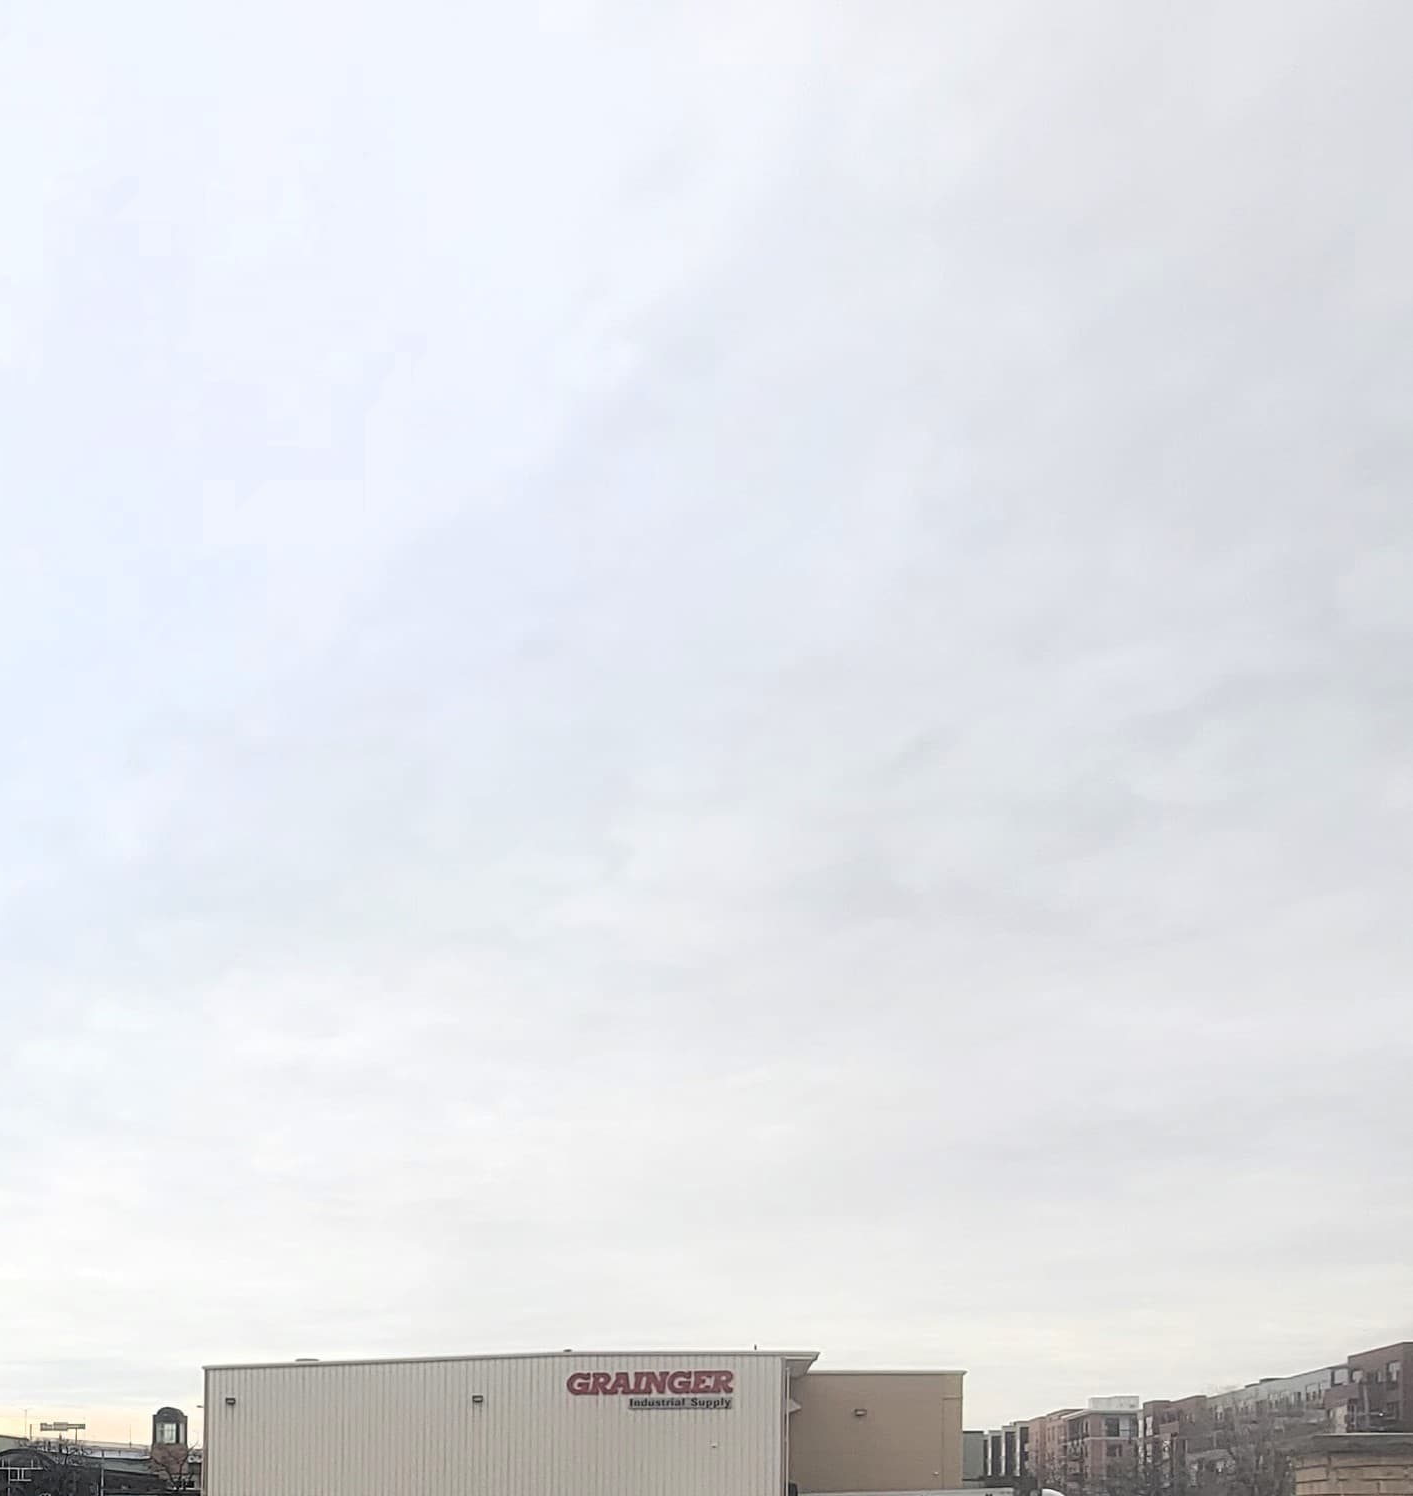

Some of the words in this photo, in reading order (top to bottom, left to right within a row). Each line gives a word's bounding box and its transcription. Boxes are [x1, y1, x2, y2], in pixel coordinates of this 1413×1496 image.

[566, 1370, 735, 1396] GRAINGER
[629, 1398, 686, 1408] Industrial
[690, 1398, 732, 1409] Supply
